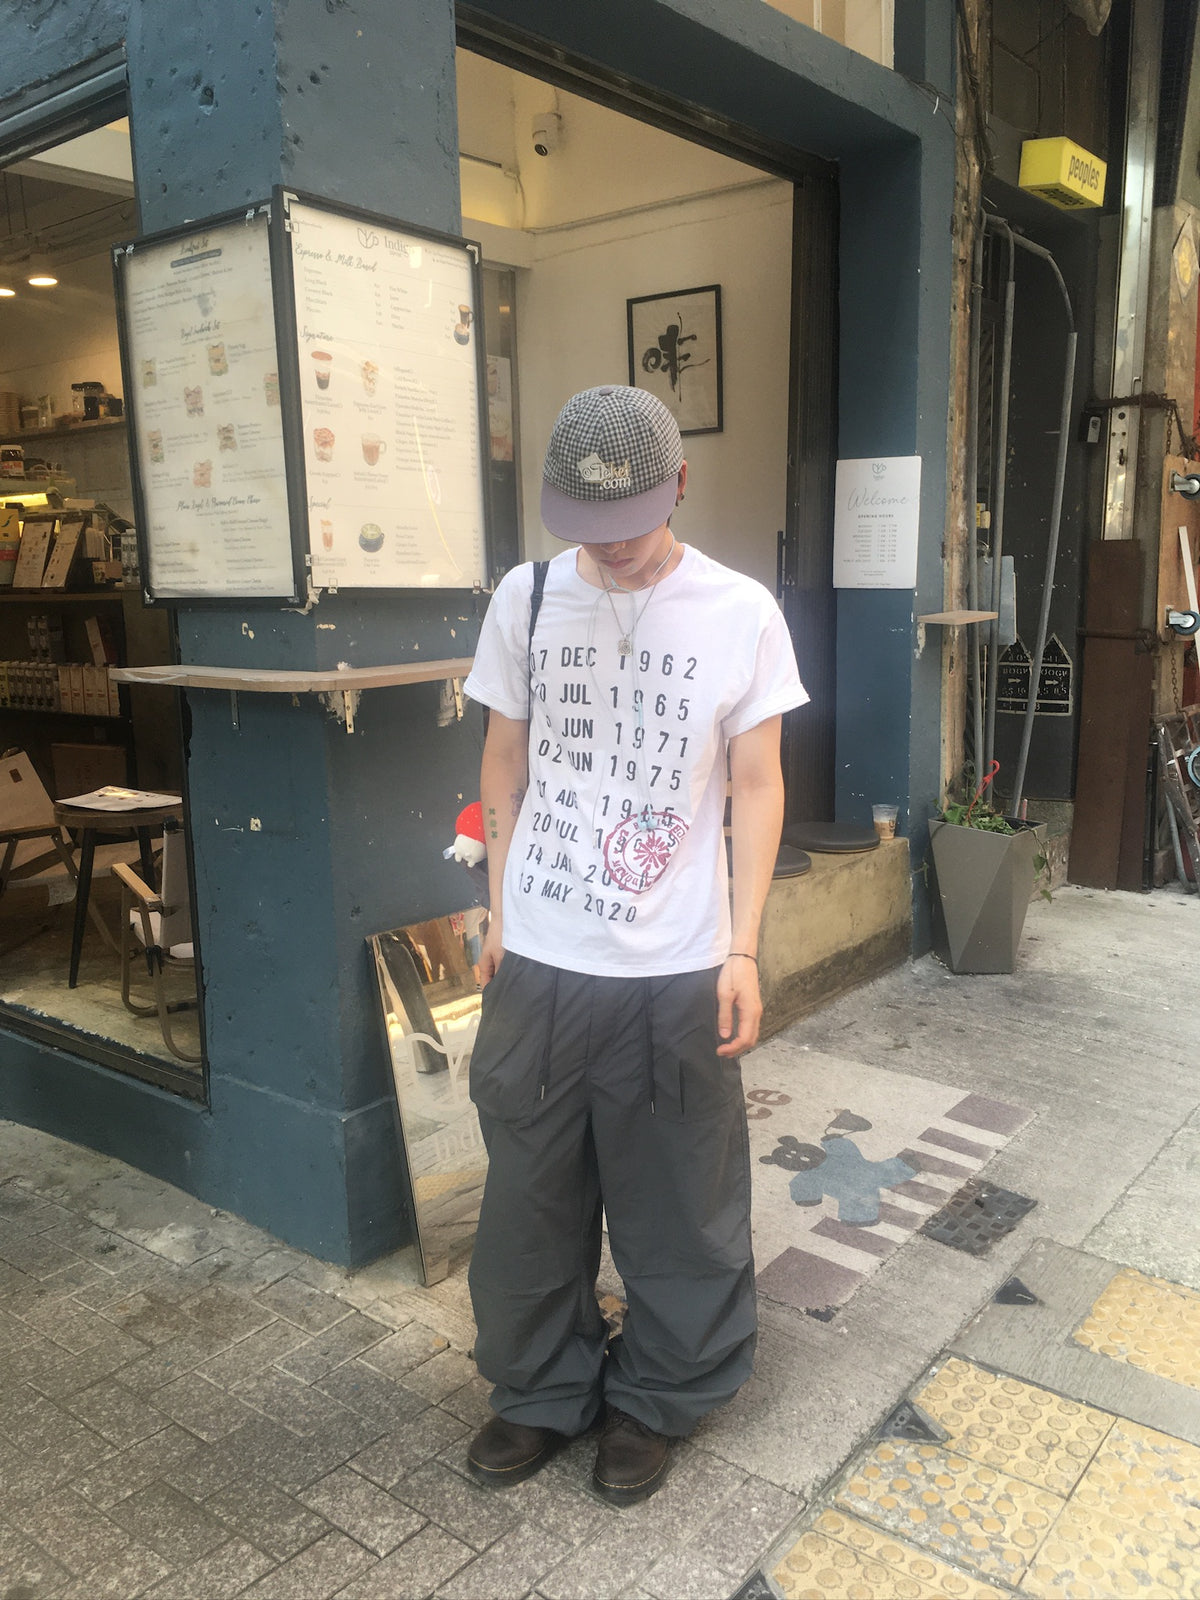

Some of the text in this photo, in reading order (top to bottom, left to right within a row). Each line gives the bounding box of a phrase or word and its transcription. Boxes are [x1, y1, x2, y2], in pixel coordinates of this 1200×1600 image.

[1067, 154, 1099, 190] peoples
[335, 252, 354, 268] Milk
[848, 488, 908, 511] Welcome
[561, 646, 597, 668] DEC
[619, 650, 698, 680] 1962
[559, 683, 592, 706] JUL
[610, 686, 690, 721] 1965
[561, 717, 594, 739] JUN
[615, 722, 688, 758] 1971
[538, 739, 562, 764] 02
[610, 755, 682, 790] 1975
[533, 813, 552, 833] 20
[526, 843, 543, 865] 14
[541, 879, 573, 903] MAY
[583, 893, 637, 923] 2020
